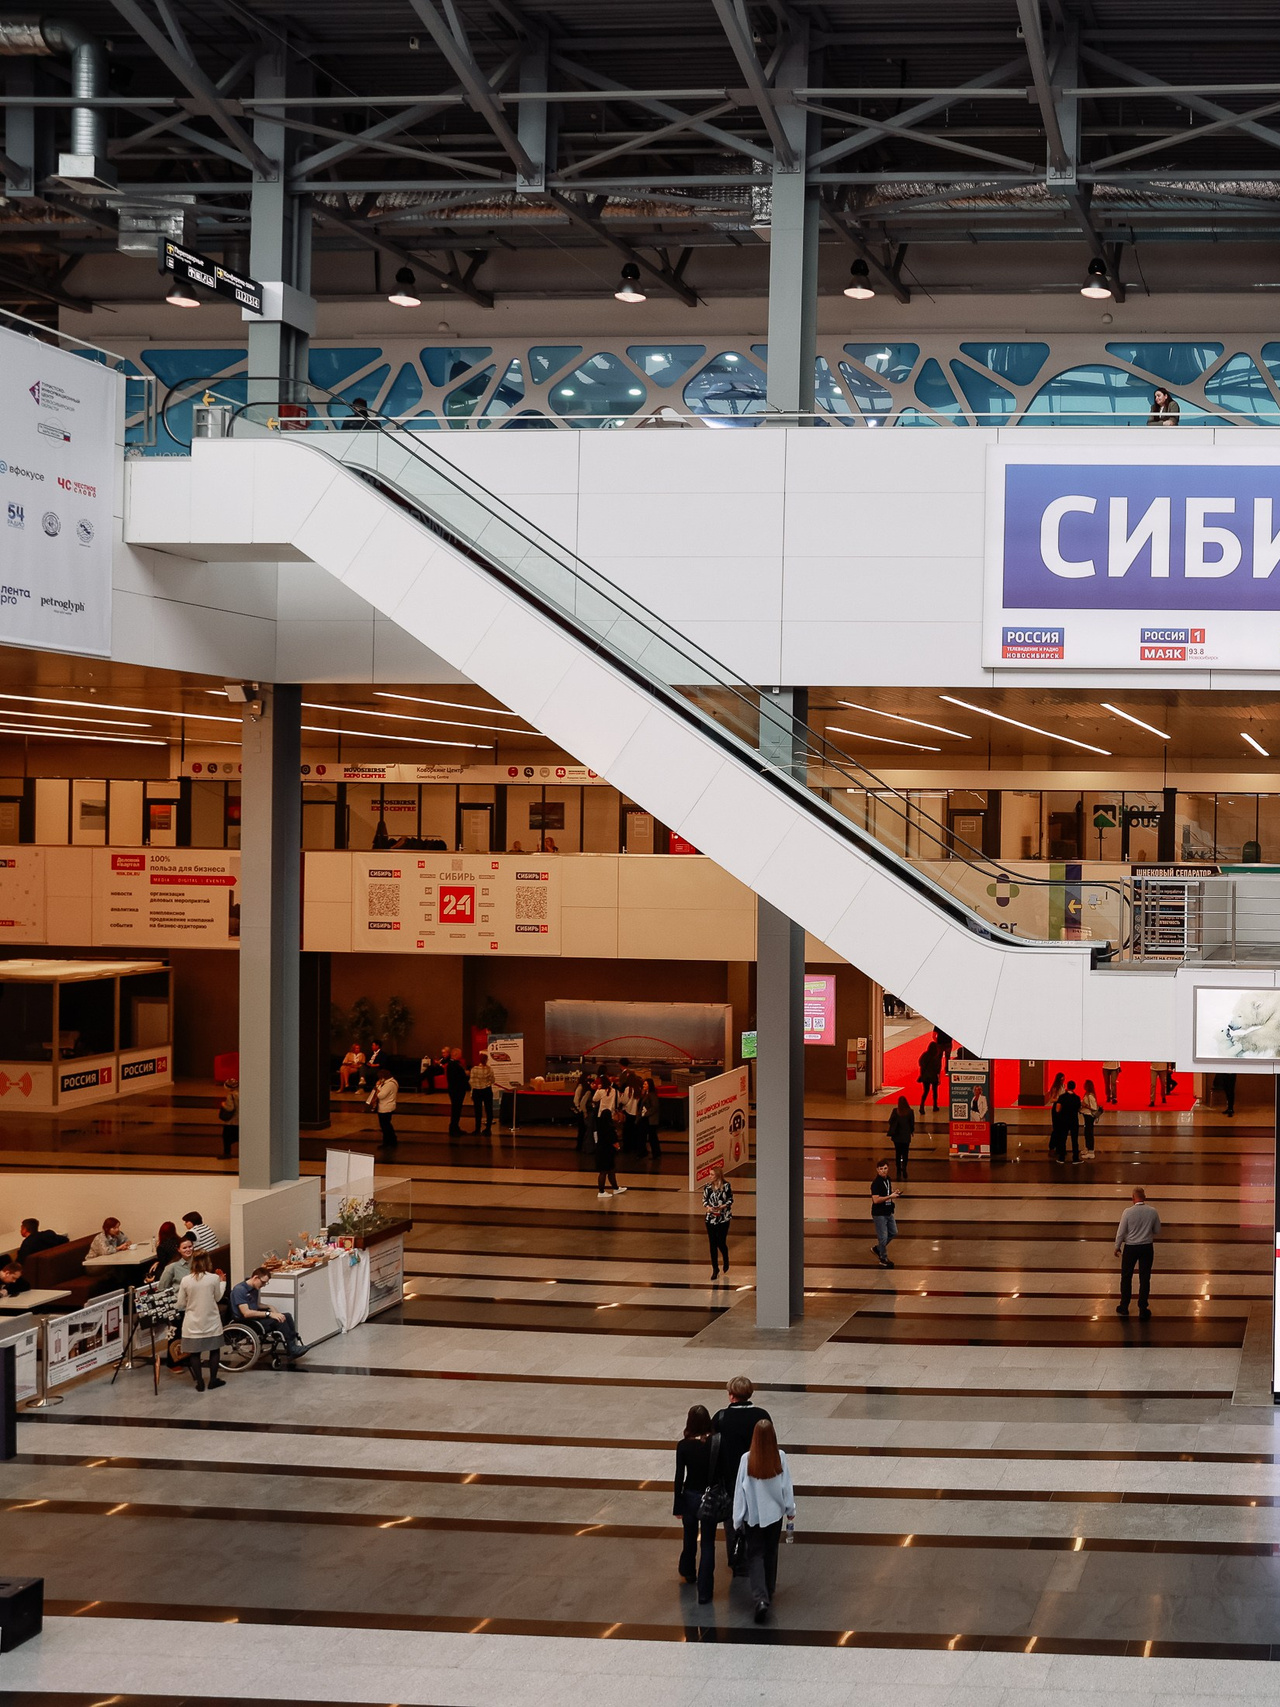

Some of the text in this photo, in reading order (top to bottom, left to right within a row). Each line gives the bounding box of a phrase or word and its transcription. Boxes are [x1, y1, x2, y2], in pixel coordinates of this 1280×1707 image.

[9, 466, 45, 481] вфокусе
[58, 477, 72, 491] ЧС
[73, 482, 96, 493] ЧЕСТНОЕ
[73, 488, 97, 498] СЛОВО
[8, 504, 25, 522] 54
[1, 585, 31, 598] лента
[41, 597, 85, 612] petroglyph
[1007, 631, 1060, 643] РОССИЯ
[1144, 630, 1201, 642] РОССИЯ 1
[1144, 648, 1183, 659] МАЯК
[1118, 817, 1159, 828] HOUS
[150, 855, 171, 863] 100%
[193, 865, 226, 873] бизнеса
[1136, 867, 1212, 877] ШНЕКОВЫЙ СЕПАРАТОР
[439, 872, 475, 881] СИБИРЬ
[443, 894, 471, 915] 24
[124, 1060, 166, 1077] РОССИЯ 24
[64, 1073, 97, 1089] РОССИЯ
